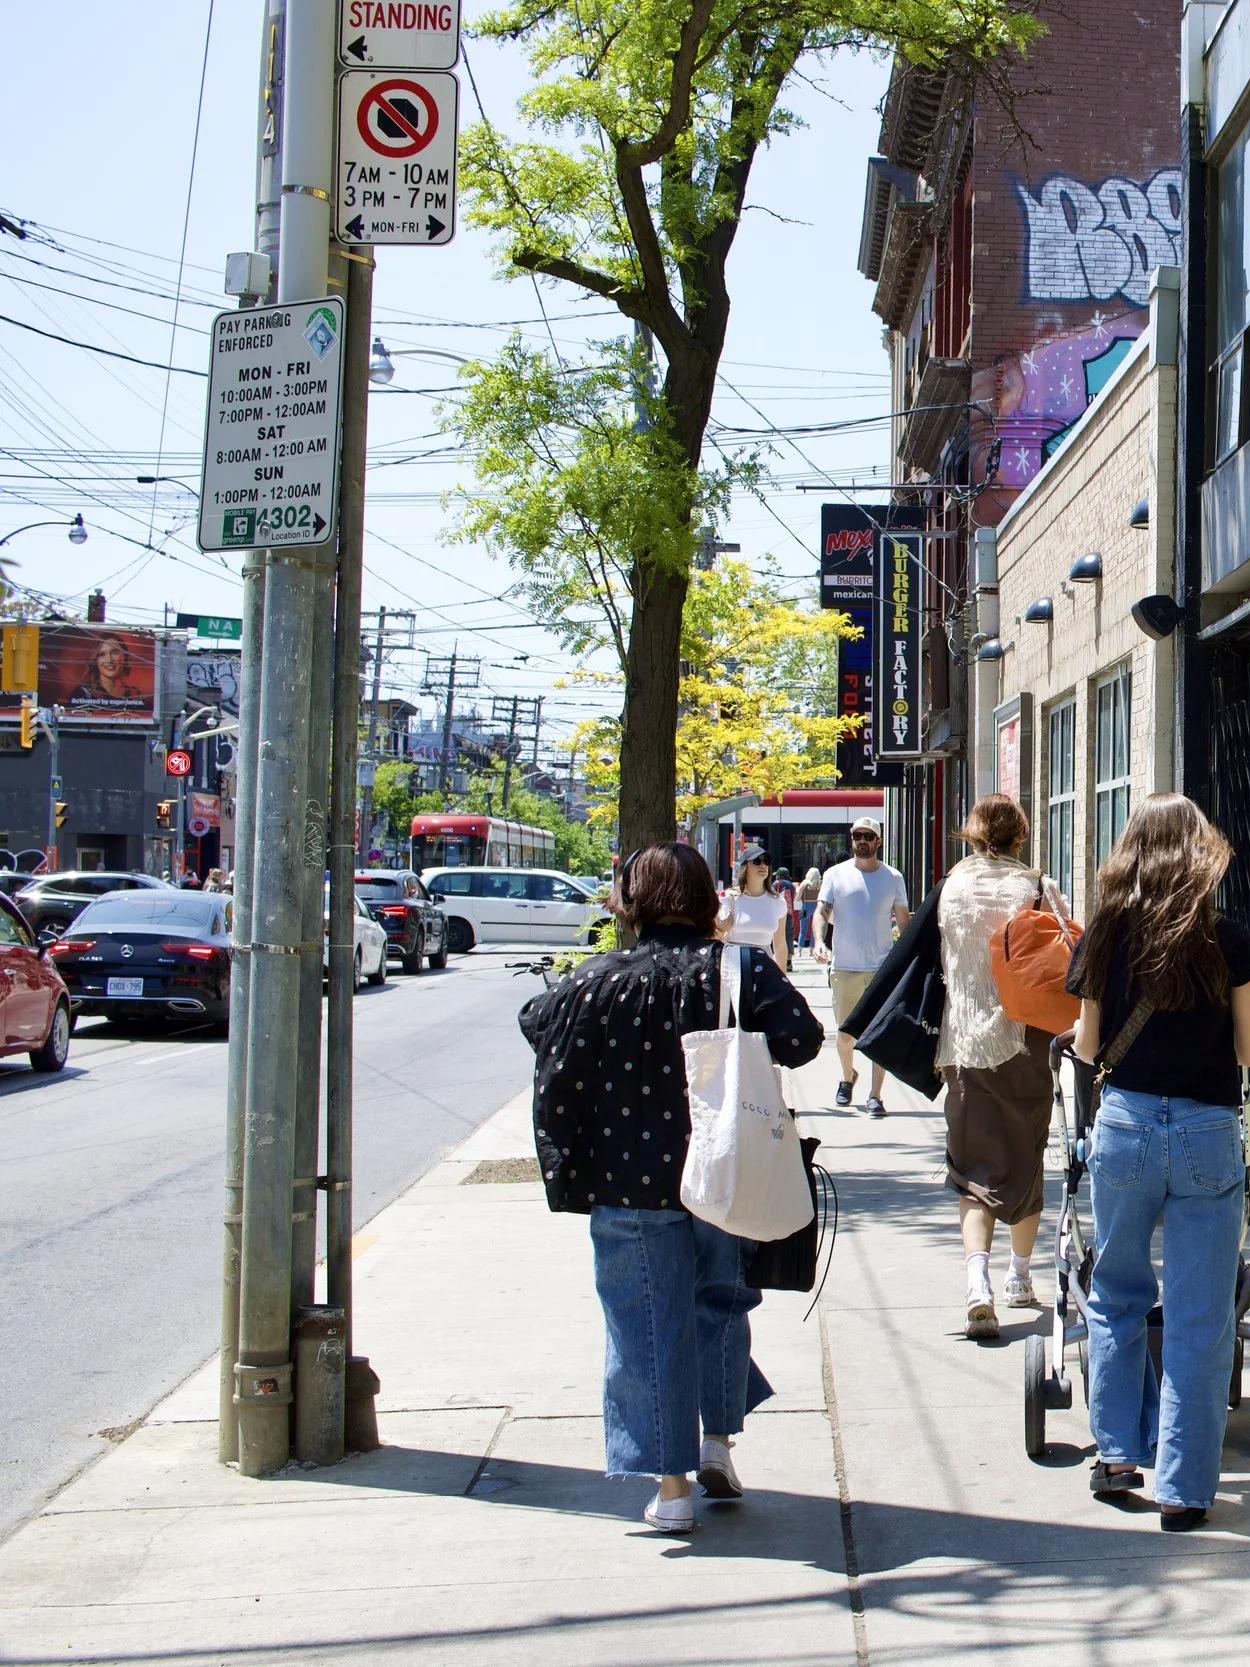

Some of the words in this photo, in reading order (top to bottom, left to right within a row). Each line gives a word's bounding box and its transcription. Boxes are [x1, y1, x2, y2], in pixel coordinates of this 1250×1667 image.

[349, 2, 452, 31] STANDING
[371, 221, 420, 234] MON-FRI
[219, 319, 241, 335] PAY
[244, 313, 291, 334] PARKG
[218, 333, 273, 353] ENFORCED
[238, 365, 272, 382] MON
[287, 361, 311, 377] FRI
[220, 385, 272, 404] 10:00AM
[283, 379, 328, 398] 3:00PM
[219, 407, 263, 424] 7:00PM
[275, 400, 326, 420] 12:00AM
[257, 425, 285, 441] SAT
[216, 447, 261, 465] 8:00AM
[254, 466, 284, 481] SUN
[214, 487, 258, 505] 1:00PM
[270, 483, 321, 501] 12:00AM
[256, 504, 311, 530] 4302
[271, 530, 301, 541] Location
[302, 529, 310, 538] ID
[892, 543, 910, 633] BURGER
[892, 640, 909, 746] FACTORY
